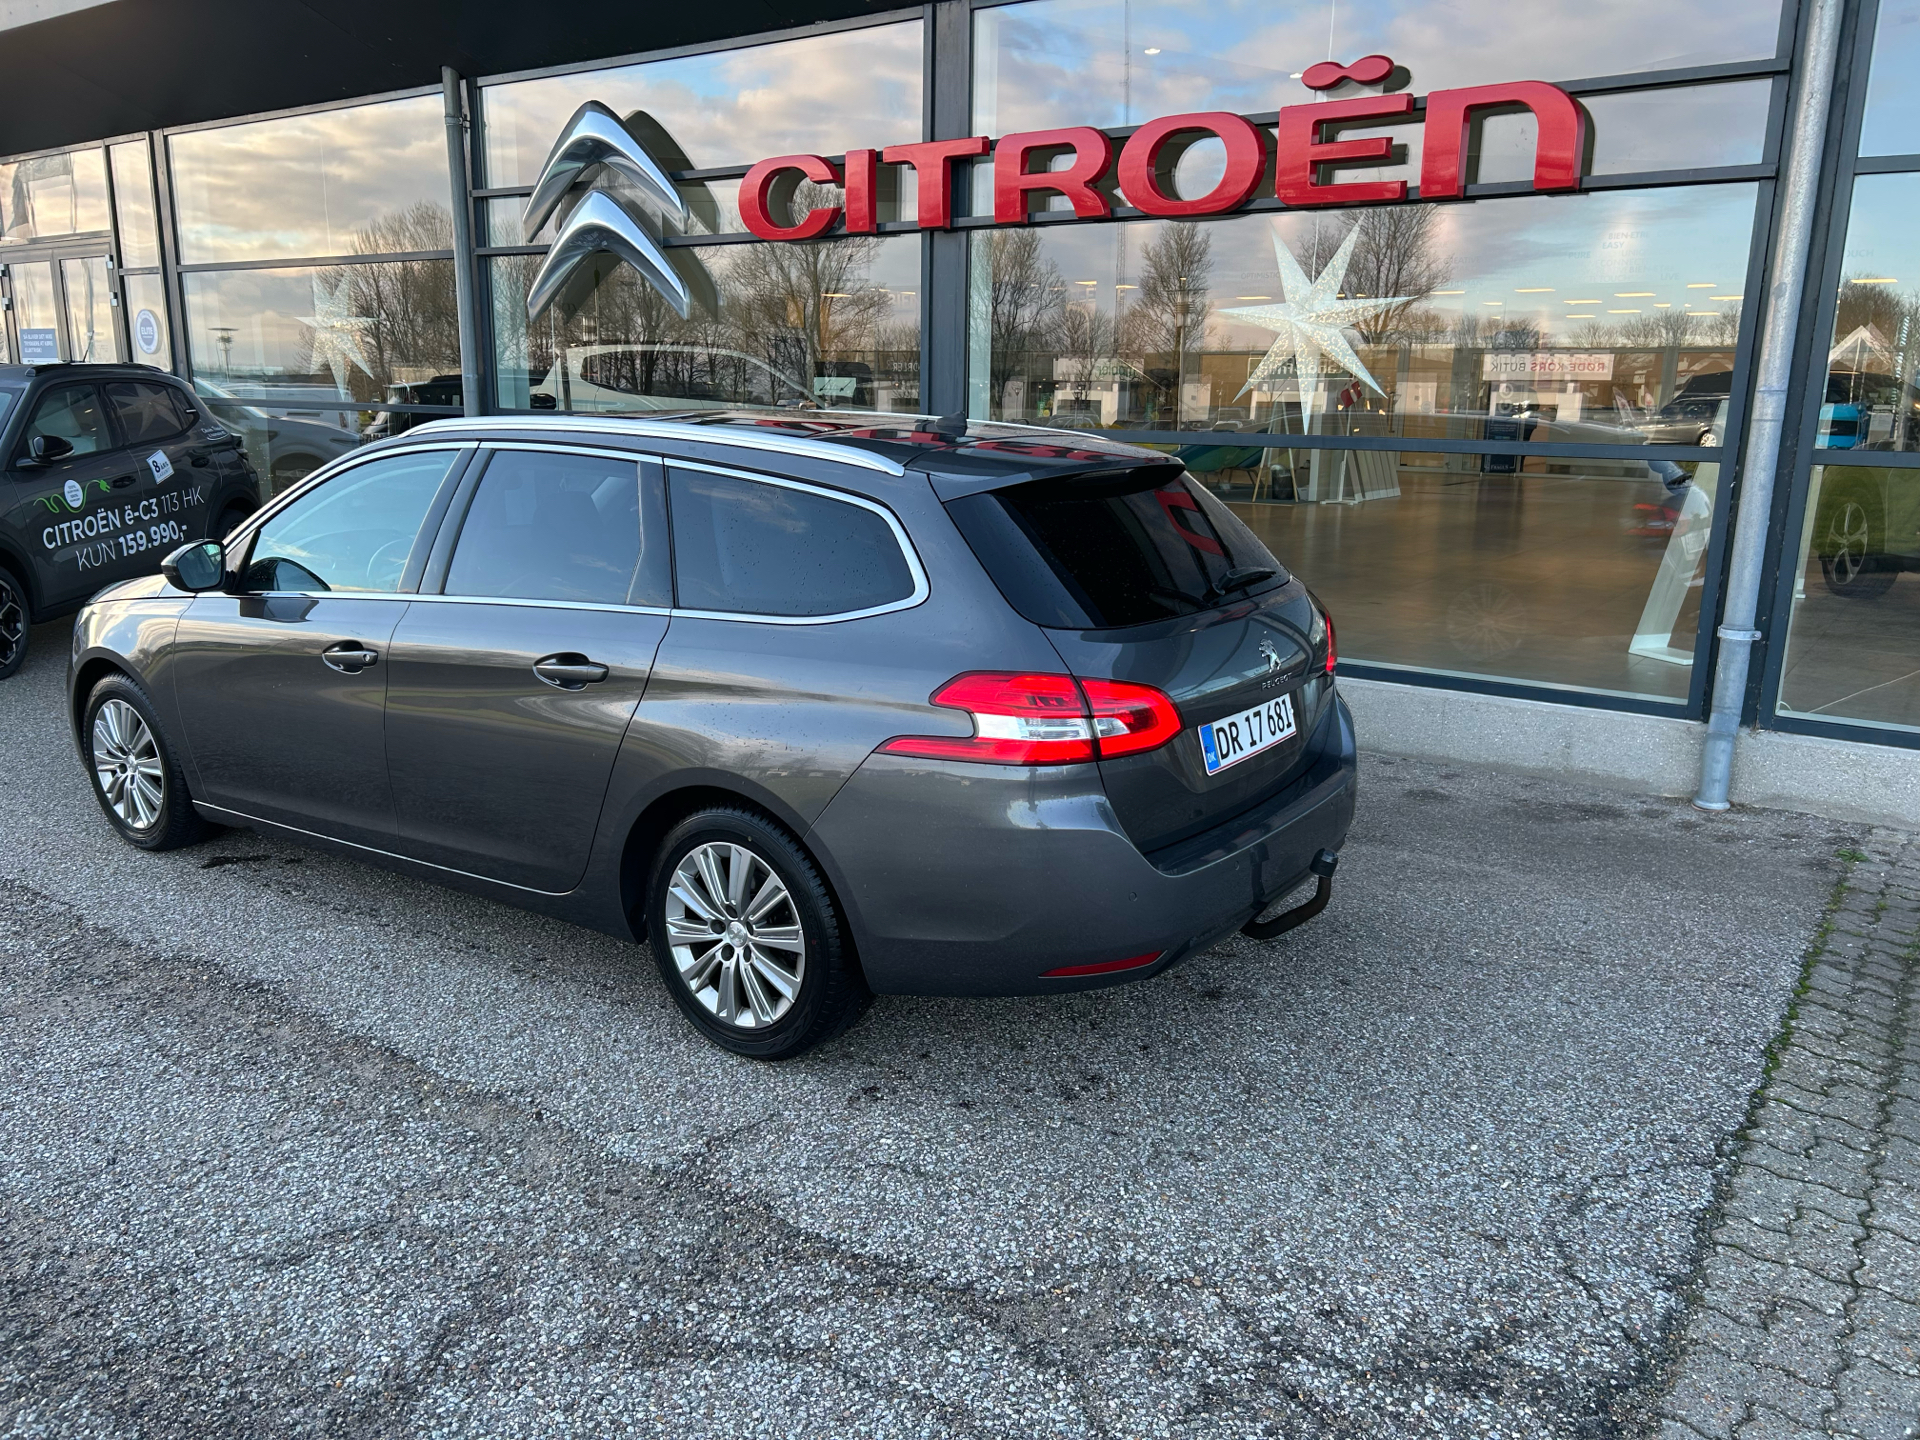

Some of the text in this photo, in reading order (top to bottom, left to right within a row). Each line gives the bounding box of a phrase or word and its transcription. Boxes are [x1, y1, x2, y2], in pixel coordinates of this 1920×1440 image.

[738, 55, 1584, 241] CITROËN
[152, 459, 161, 474] 8
[42, 485, 205, 550] CITROËN ë-C3 113 HK
[75, 520, 188, 572] KUN 159.990,-
[1261, 672, 1292, 691] PEUGEOT
[1215, 698, 1292, 761] DR 17 681
[1207, 752, 1217, 764] DK
